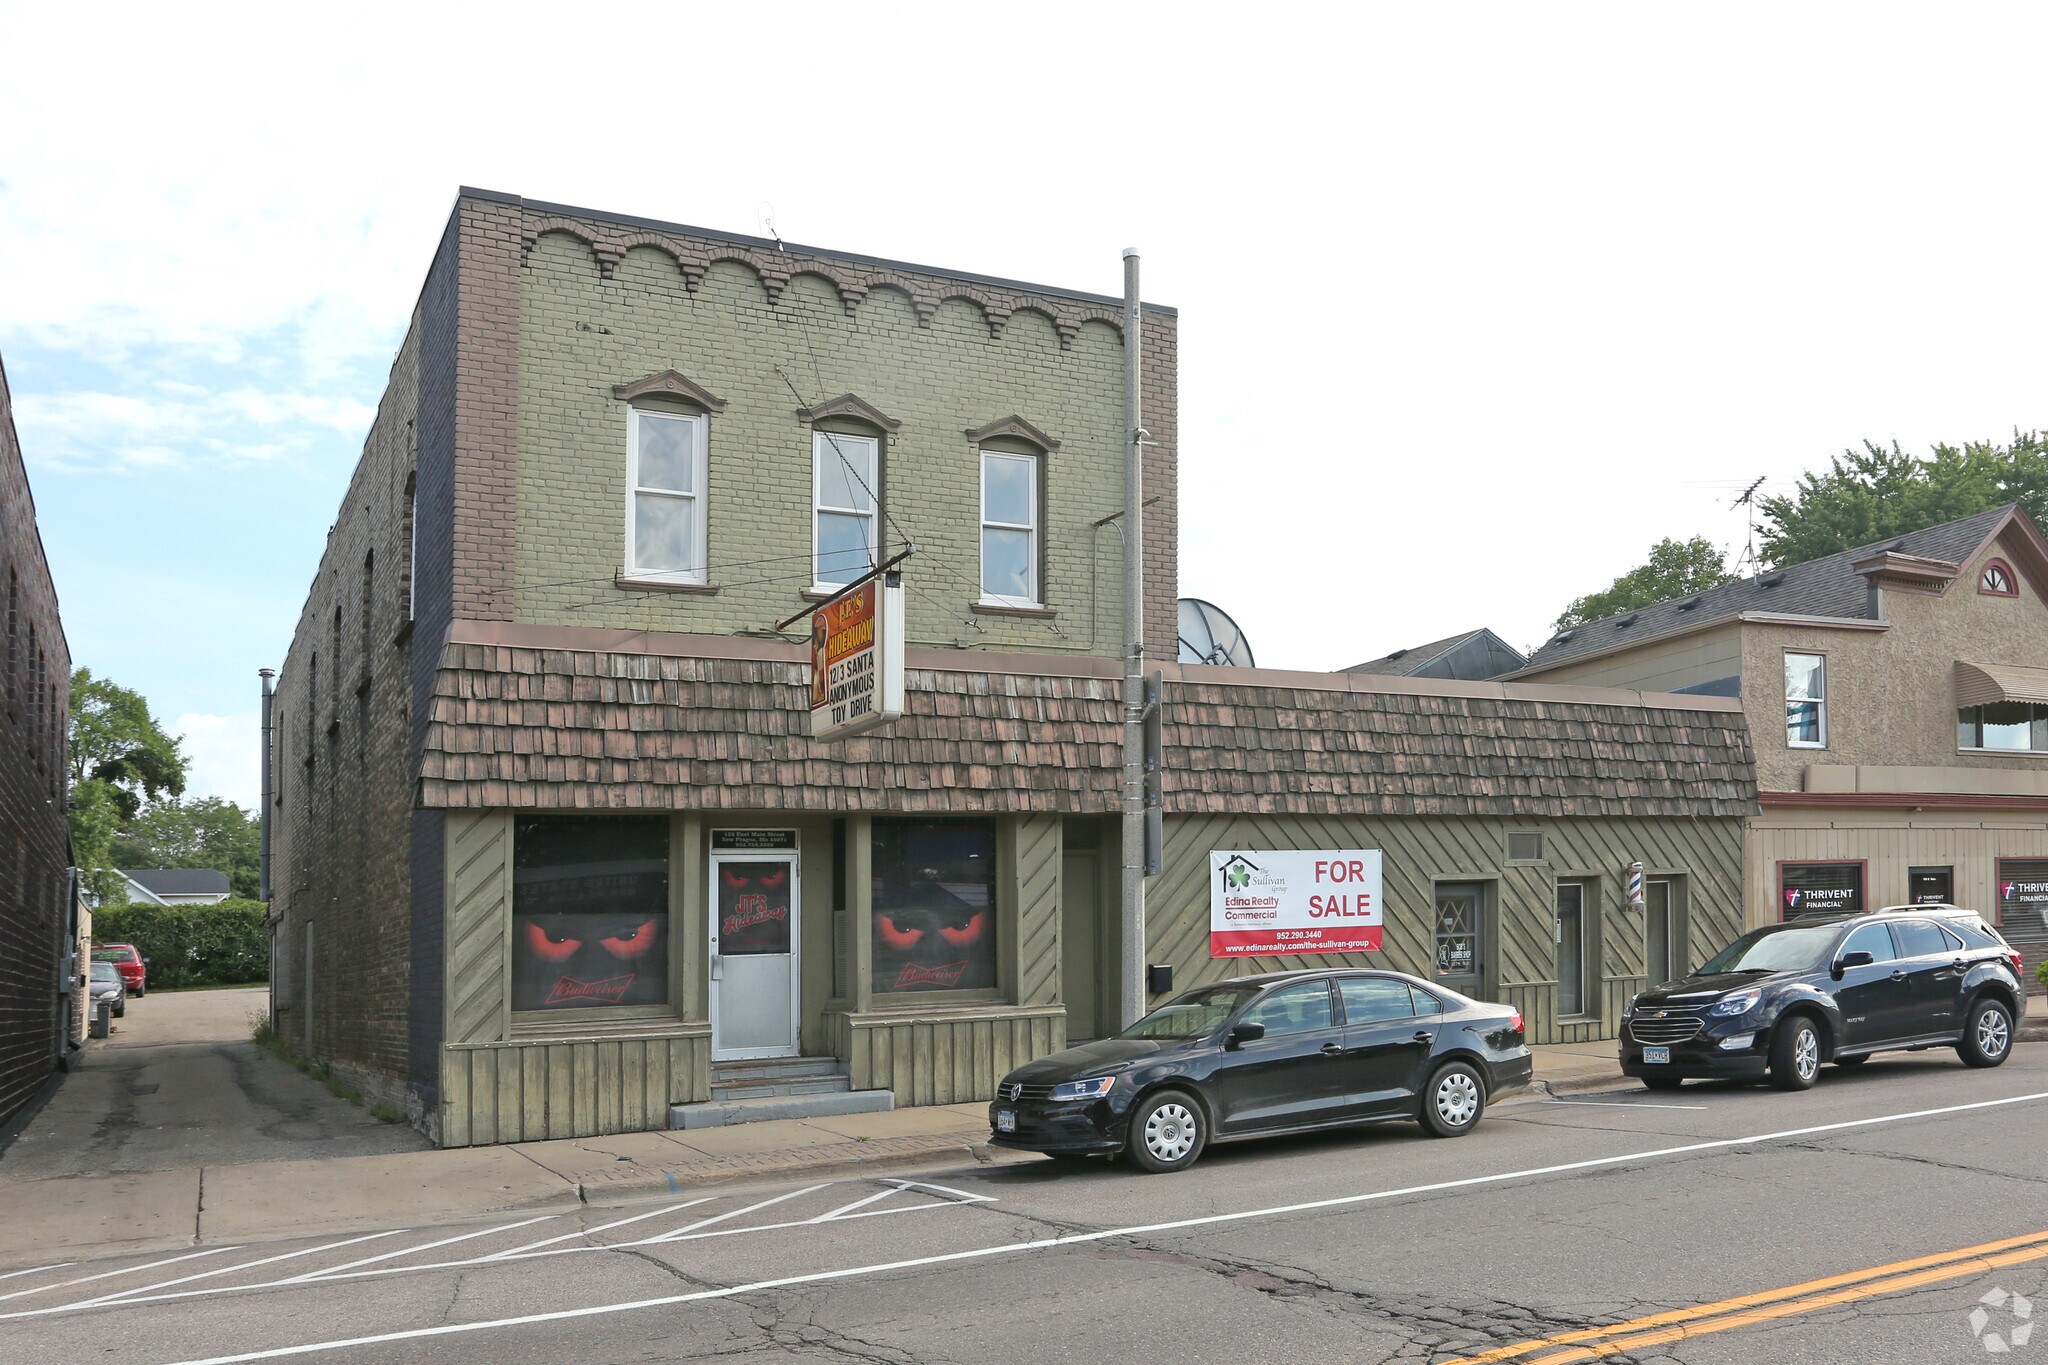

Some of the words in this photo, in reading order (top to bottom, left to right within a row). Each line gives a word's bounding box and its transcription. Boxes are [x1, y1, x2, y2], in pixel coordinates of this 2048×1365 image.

[828, 617, 874, 659] HIDEAWAY
[846, 651, 874, 678] SANTA
[829, 672, 874, 706] ANONYMOUS
[831, 704, 846, 725] TOY
[850, 694, 872, 718] DRIVE
[1315, 860, 1365, 883] FOR
[1252, 874, 1285, 886] Sullivan
[1804, 889, 1853, 899] THRIVENT
[1225, 897, 1250, 906] Edina
[1252, 896, 1279, 908] Realty
[1308, 894, 1371, 918] SALE
[1225, 910, 1277, 920] Commercial
[1276, 931, 1322, 940] 952.290.3440
[1225, 940, 1369, 953] www.edinarealty.com/the-sullivan-group
[902, 967, 961, 981] Budweiser
[555, 982, 625, 996] Budweiser
